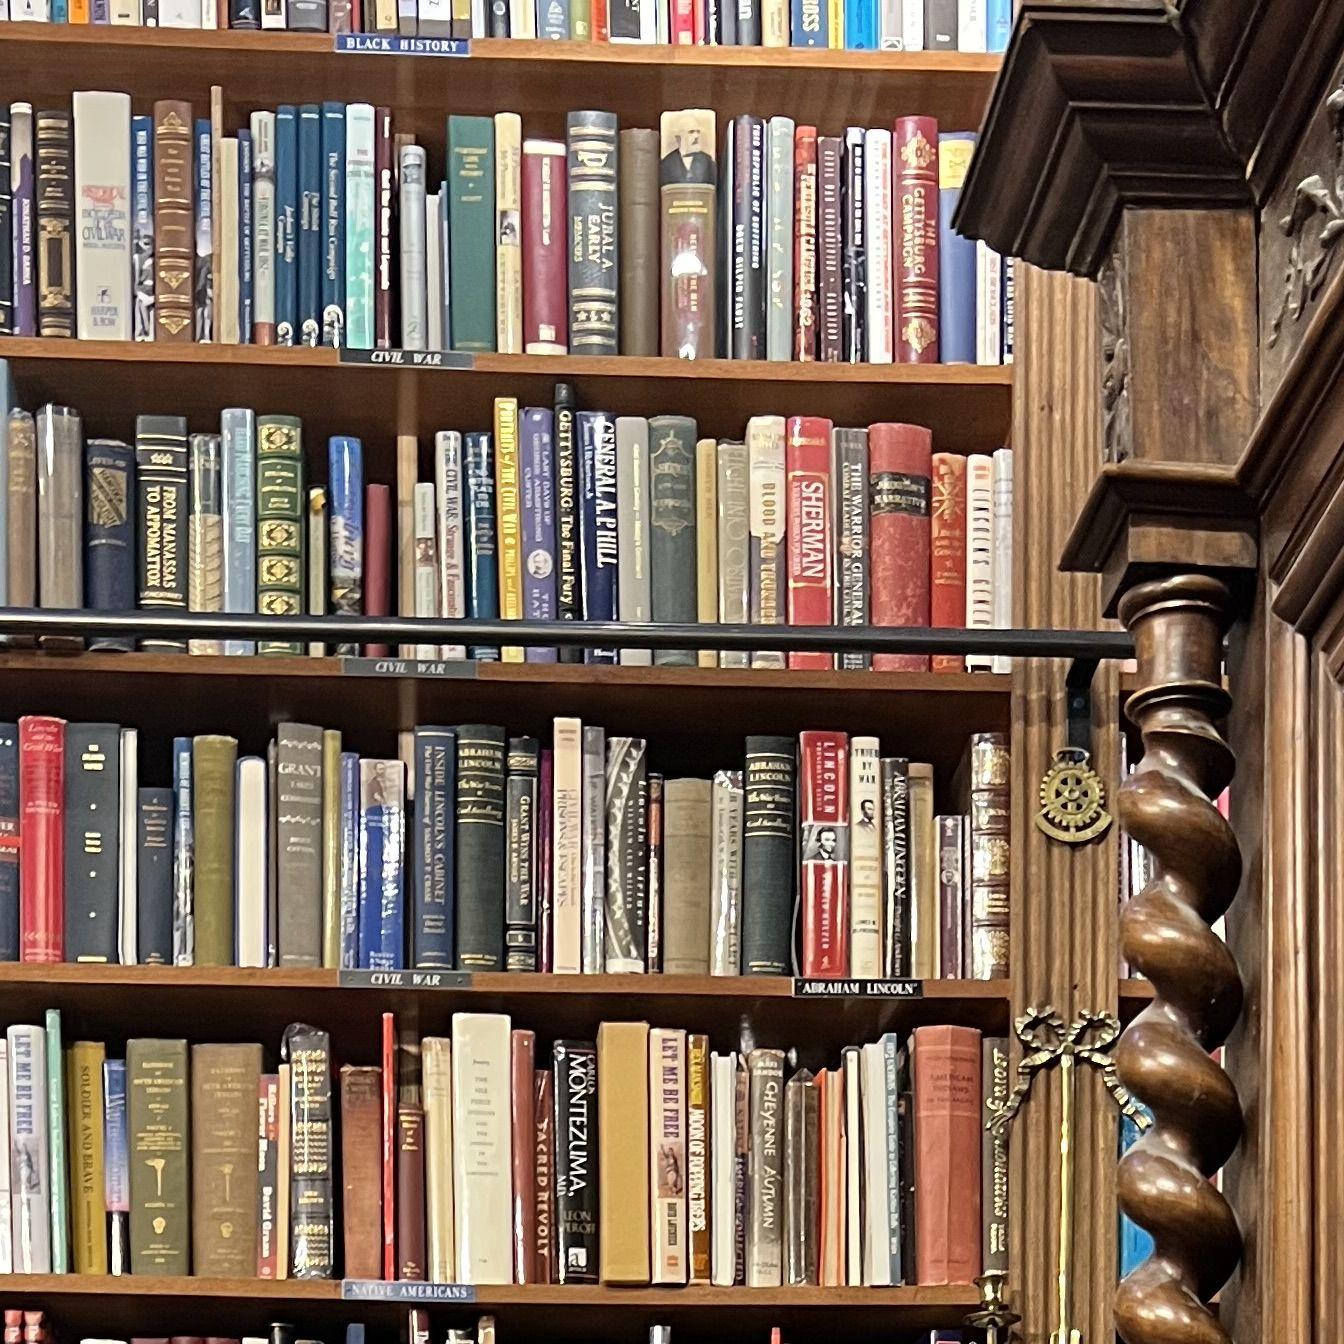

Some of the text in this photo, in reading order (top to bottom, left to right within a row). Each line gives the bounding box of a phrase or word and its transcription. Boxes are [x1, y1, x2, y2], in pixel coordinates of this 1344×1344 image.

[346, 37, 460, 52] BLACK HISTORY
[587, 214, 600, 263] EARLY
[599, 202, 613, 253] JUBAL
[902, 194, 913, 267] CAMPAIGN
[912, 187, 925, 274] GETTYSBURG
[370, 352, 442, 365] CIVIL WAR
[595, 421, 617, 498] GENERAL
[146, 485, 160, 587] TO APPOMATTOX
[162, 485, 176, 588] FROM MANASSAS
[558, 410, 574, 604] GETTYSBURG: The Final Fury
[801, 481, 824, 578] SHERMAN
[596, 531, 617, 568] HILL
[375, 661, 446, 674] CIVIL WAR
[278, 763, 320, 774] GRANT
[824, 741, 835, 814] LINCOLN
[520, 796, 530, 829] GRANT
[520, 882, 530, 906] WAR
[370, 974, 440, 986] CIVIL WAR
[14, 1034, 33, 1135] LET ME BE FREE
[662, 1037, 679, 1138] LET ME BE FREE
[80, 1065, 93, 1193] SOLDIER AND BRAVE
[568, 1053, 587, 1197] MONTEZUMA,
[762, 1080, 779, 1229] CHEYENNE AUTUMN
[351, 1284, 468, 1299] NATIVE AMERICANS
